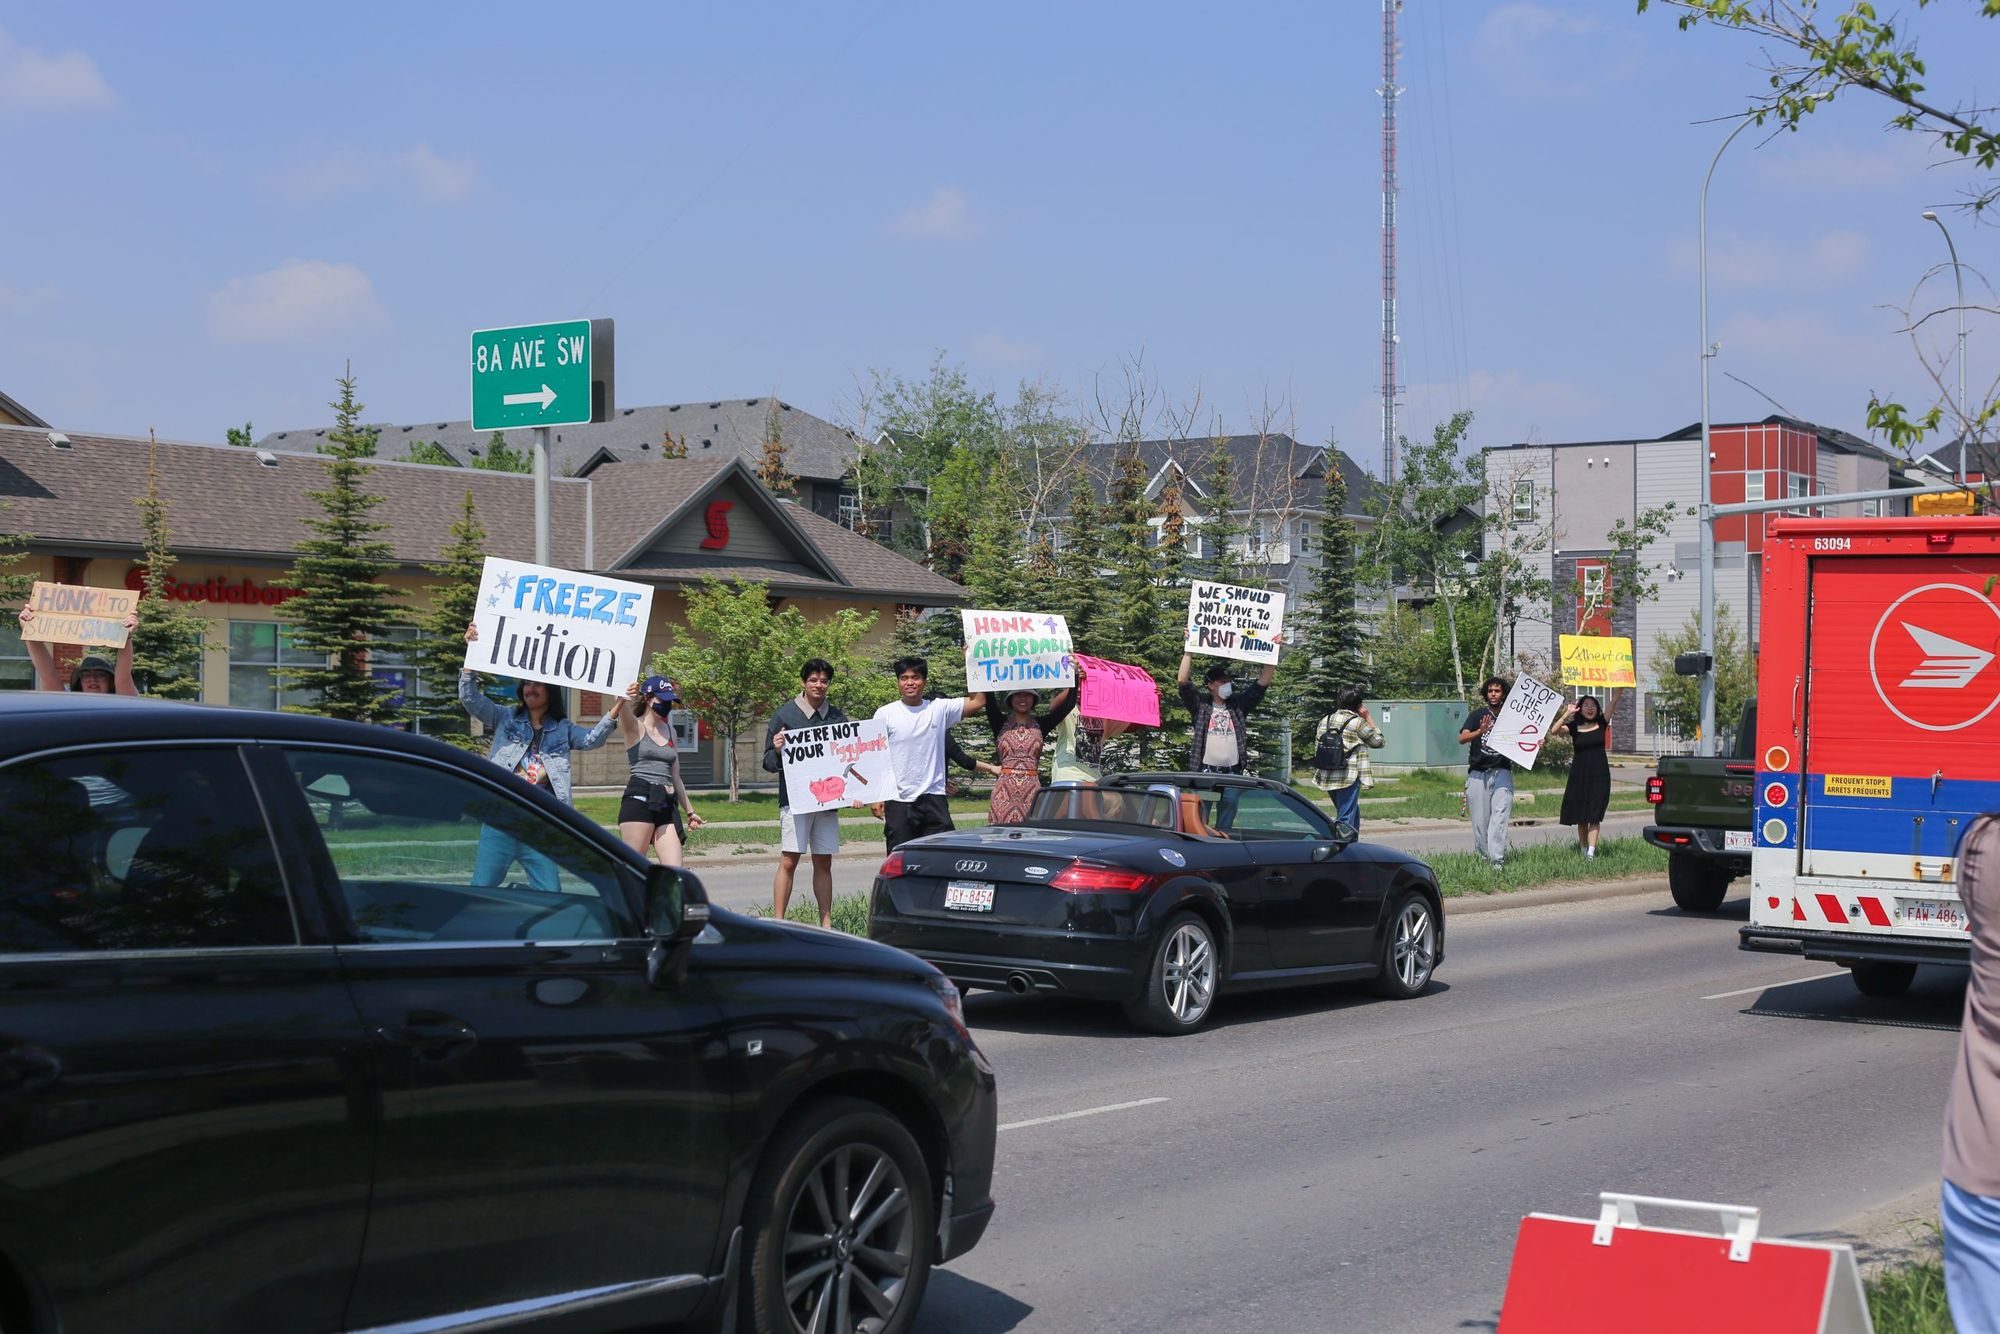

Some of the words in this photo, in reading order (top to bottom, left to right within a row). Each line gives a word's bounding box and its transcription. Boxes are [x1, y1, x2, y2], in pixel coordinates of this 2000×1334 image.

[476, 344, 503, 373] 8A
[511, 339, 546, 370] AVE
[557, 335, 585, 366] SW
[1814, 538, 1851, 550] 63094
[108, 597, 129, 612] TO
[514, 575, 642, 628] FREEZE
[1198, 586, 1222, 600] WE
[1225, 586, 1271, 604] SHOULD
[1194, 613, 1232, 626] CHOOSE
[1199, 601, 1221, 614] NOT
[1224, 604, 1253, 617] HAVE
[1257, 608, 1270, 620] TO
[974, 616, 1035, 635] HONK
[973, 637, 1072, 658] AFFORDABLE
[1198, 627, 1237, 648] RENT
[1240, 635, 1274, 653] TUITION
[488, 613, 616, 688] Tuition
[1581, 667, 1608, 682] LESS
[1520, 678, 1556, 704] STOP
[1523, 693, 1542, 712] THE
[1510, 699, 1544, 726] CUTS!!
[784, 726, 829, 745] WE'RE
[832, 722, 860, 741] NOT
[784, 743, 824, 765] YOUR
[1721, 780, 1753, 796] Jee
[1831, 777, 1864, 785] FREQUENT
[1866, 778, 1886, 786] STOPS
[946, 888, 993, 904] CGY-8454
[1907, 907, 1957, 922] FAW-486
